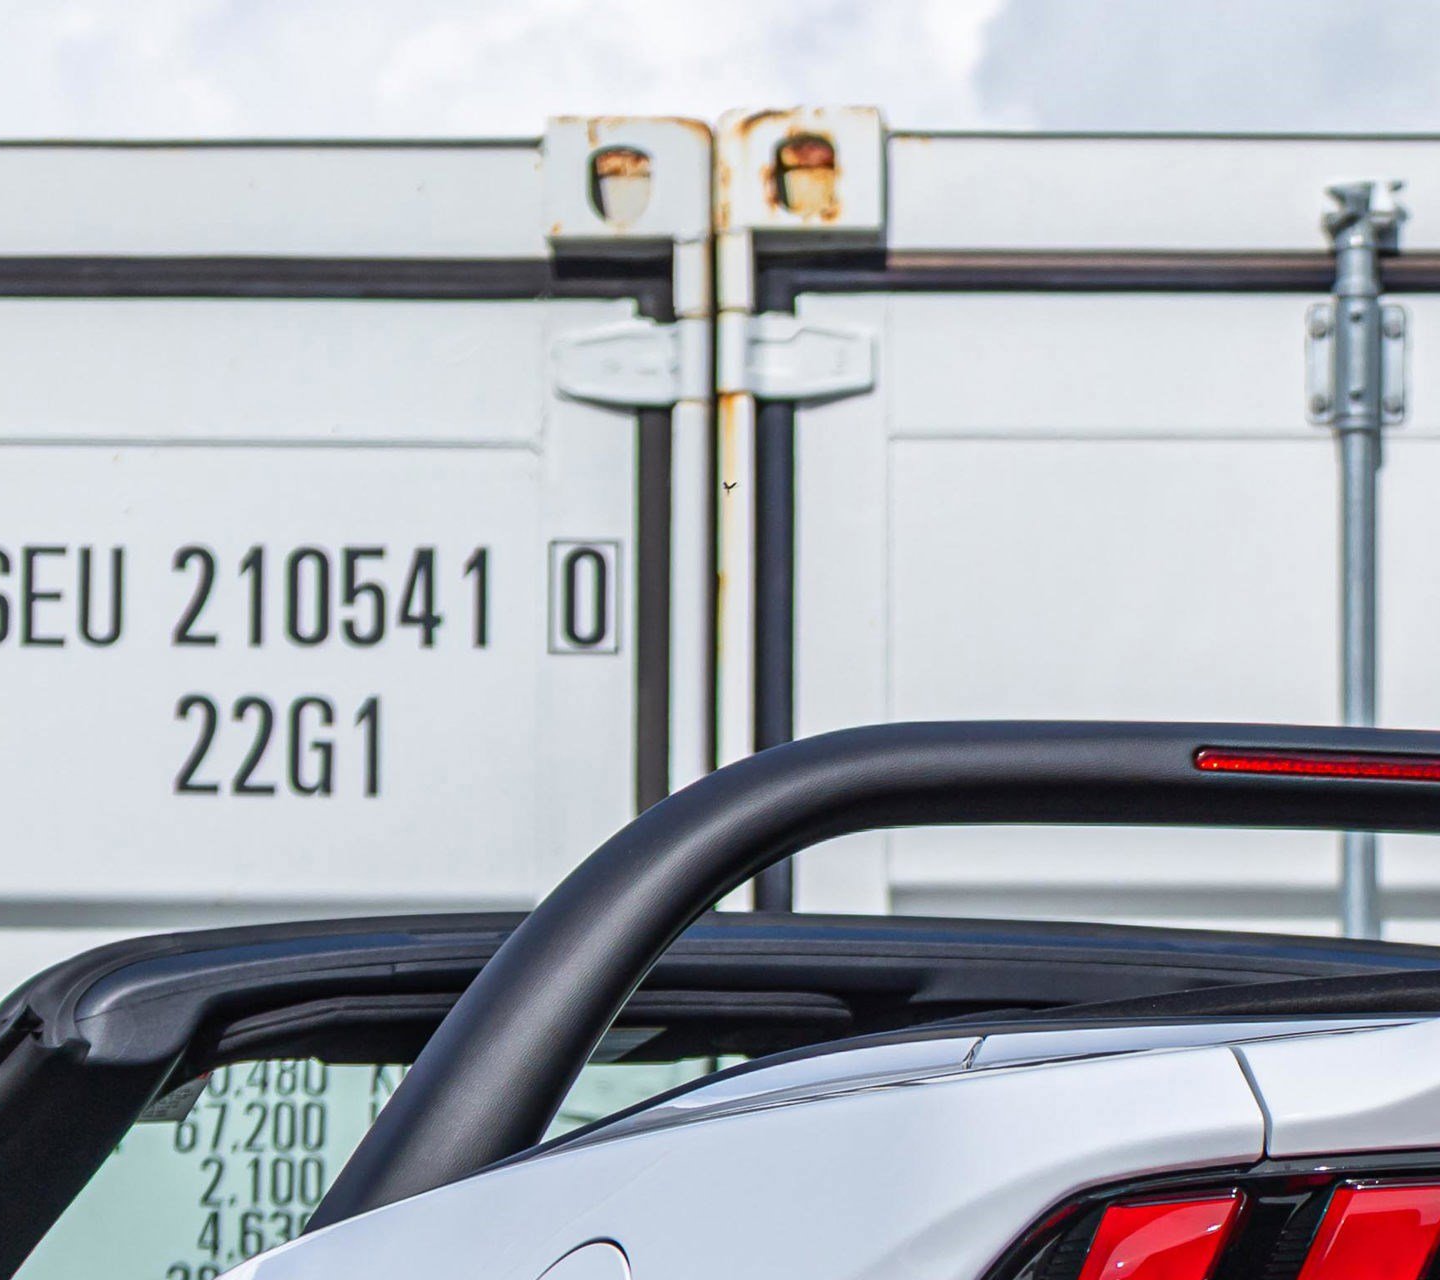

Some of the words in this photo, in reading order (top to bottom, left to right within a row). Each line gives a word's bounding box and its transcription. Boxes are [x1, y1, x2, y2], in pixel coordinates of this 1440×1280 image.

[173, 545, 489, 649] 210541
[564, 546, 608, 649] 0
[174, 694, 381, 798] 22G1
